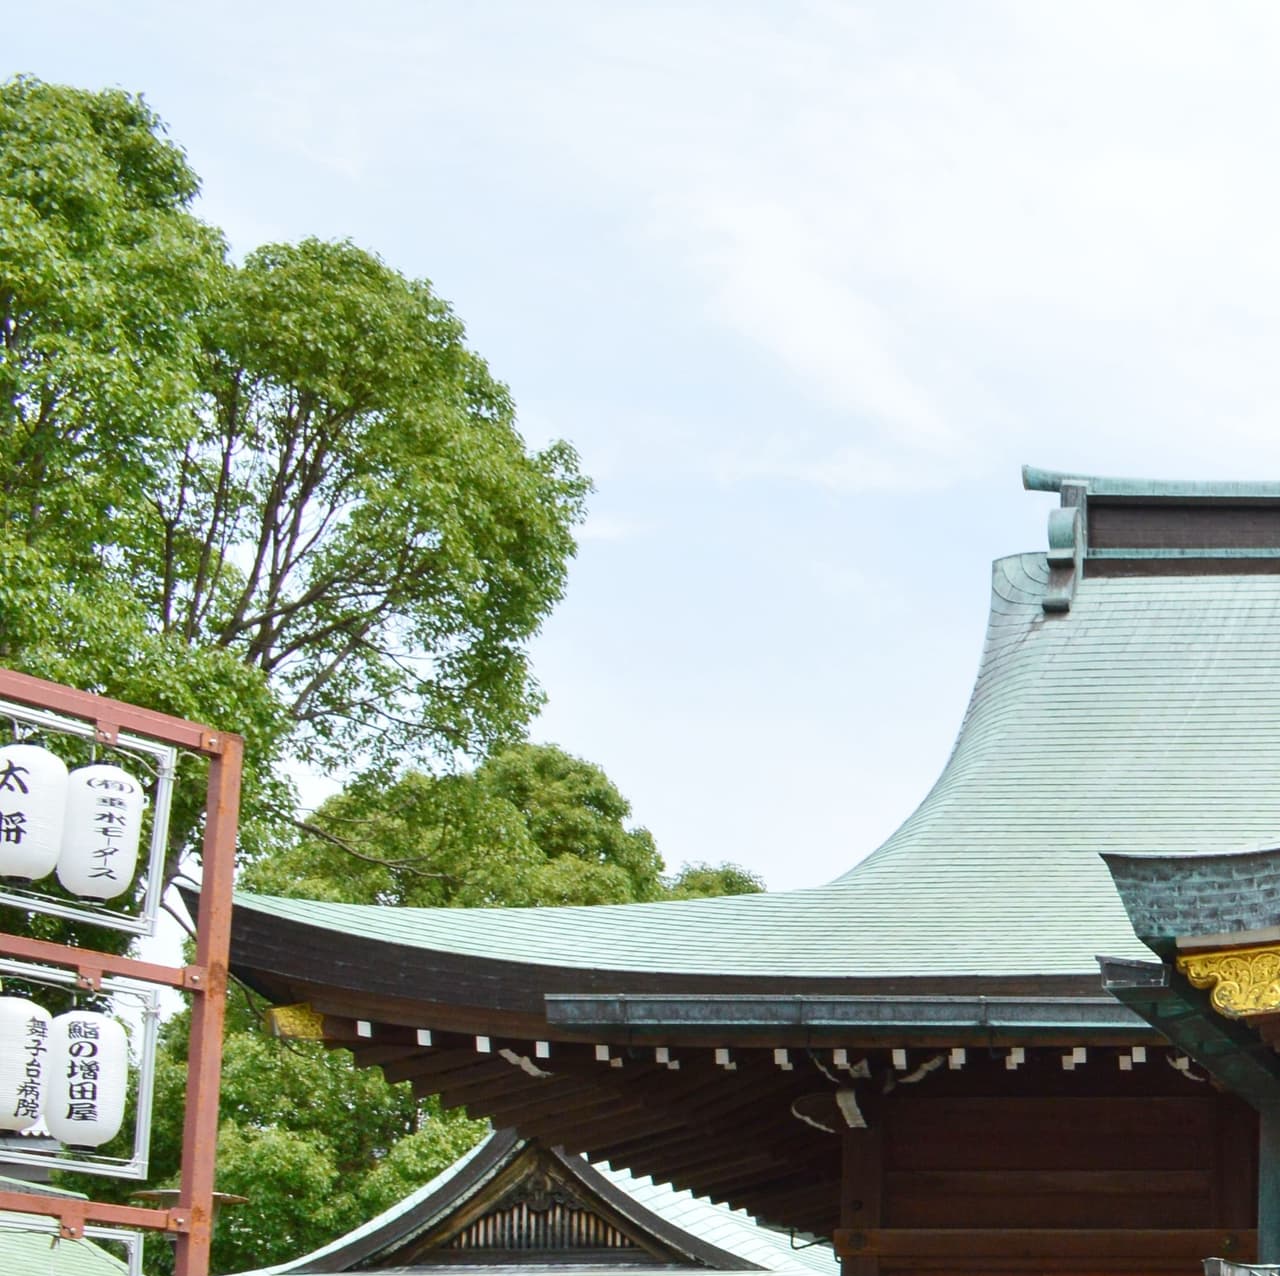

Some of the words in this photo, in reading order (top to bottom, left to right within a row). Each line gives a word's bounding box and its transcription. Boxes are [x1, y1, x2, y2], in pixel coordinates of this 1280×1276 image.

[13, 1016, 48, 1119] 舞子台病院
[65, 1020, 100, 1121] 鮨の増田屋
